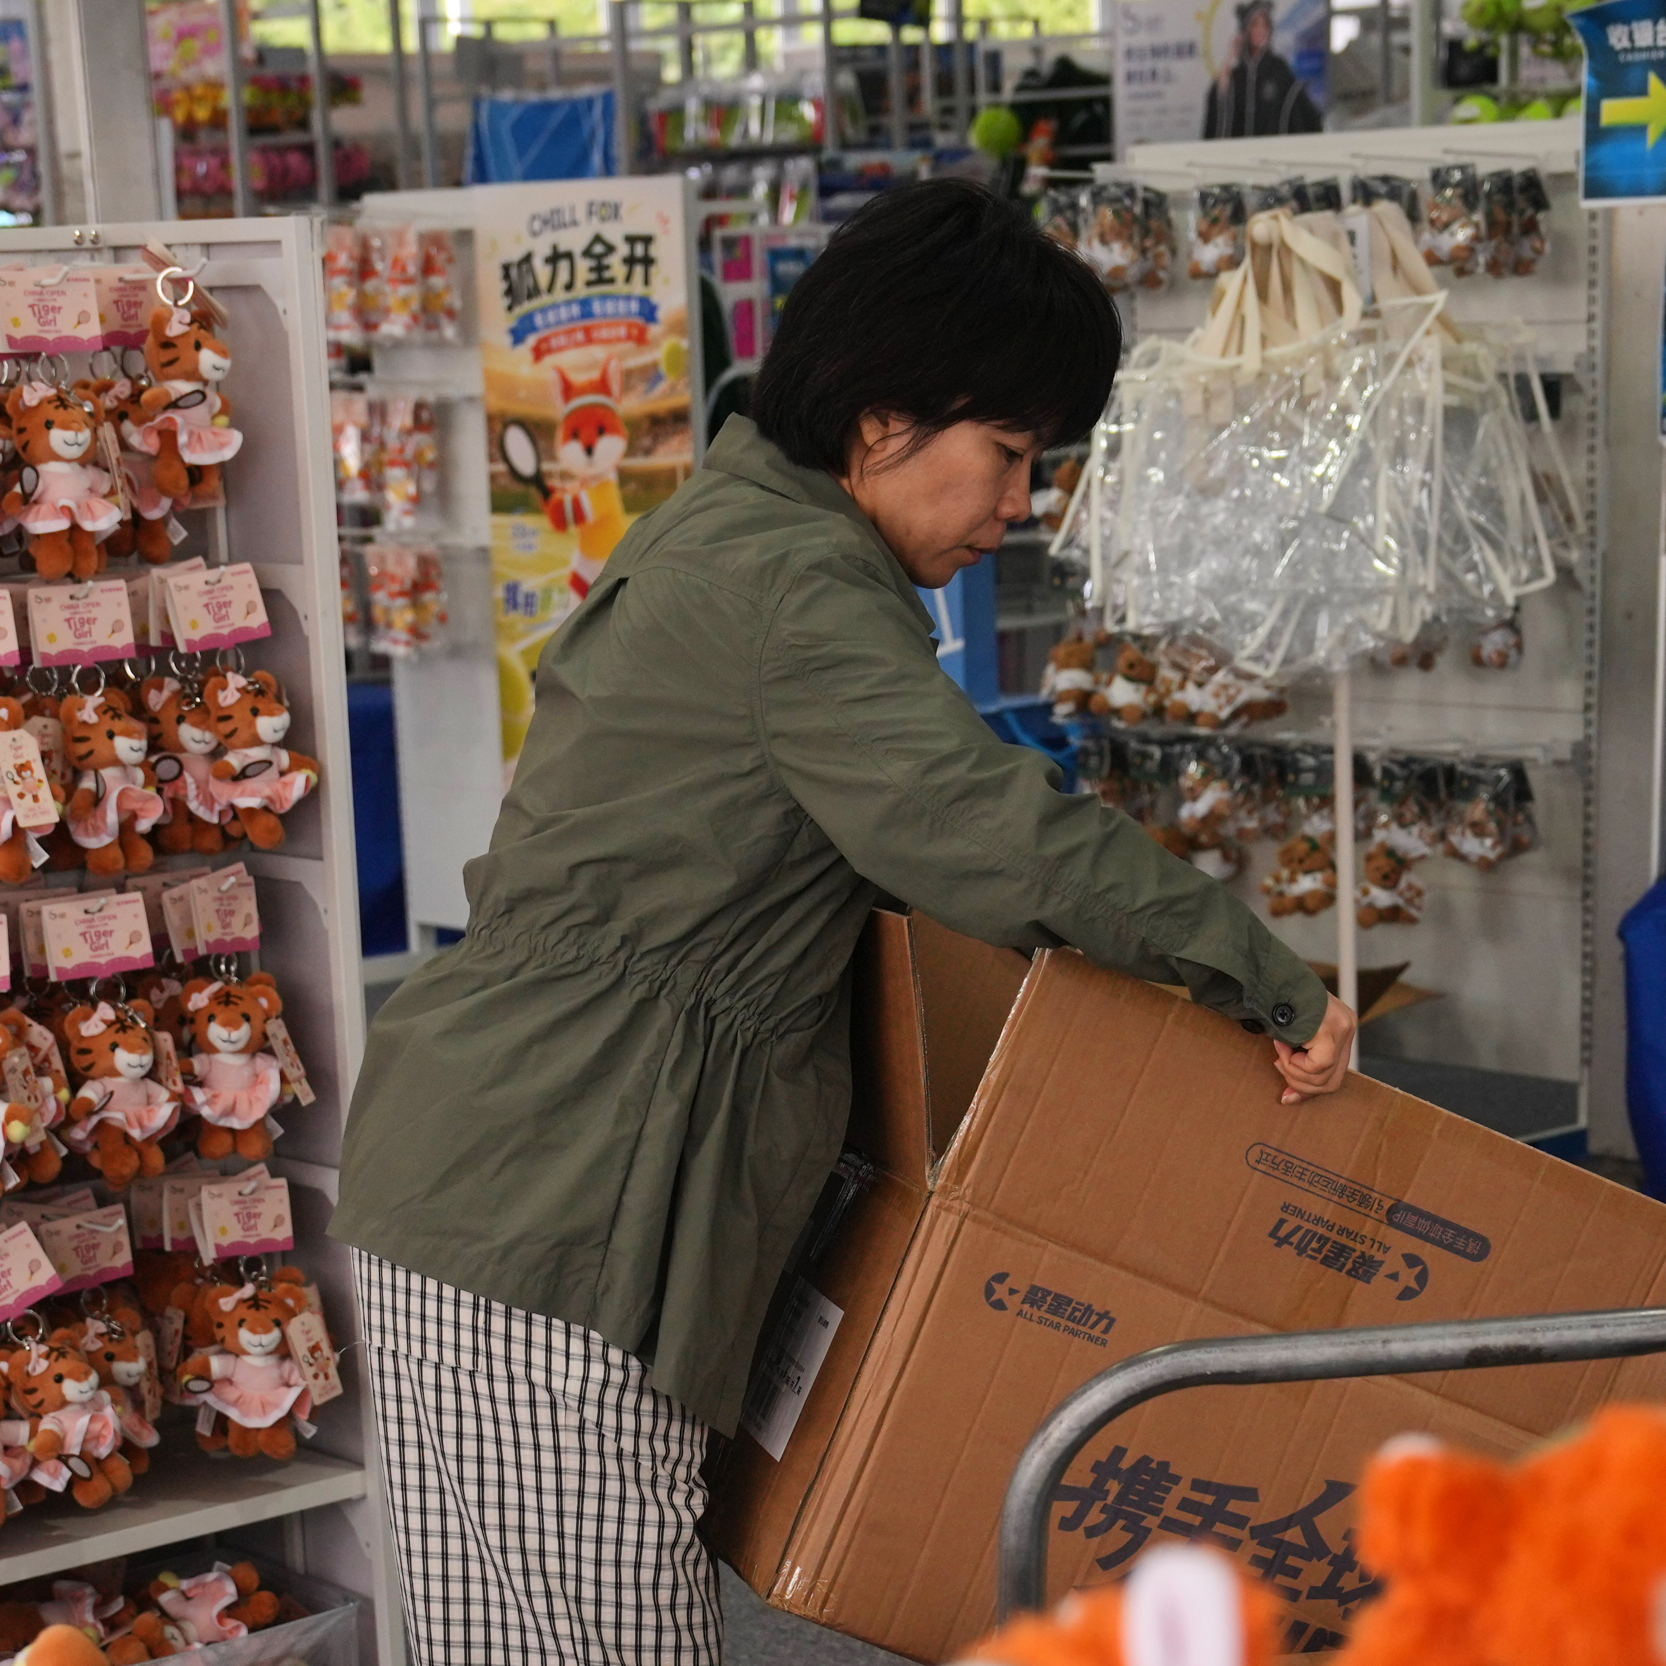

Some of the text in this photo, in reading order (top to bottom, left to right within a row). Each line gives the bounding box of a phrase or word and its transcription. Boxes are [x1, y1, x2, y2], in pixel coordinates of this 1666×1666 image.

[529, 200, 623, 237] CHILL FOX
[501, 233, 656, 313] 狐力全开
[1268, 1217, 1385, 1284] 聚星动力
[1280, 1200, 1392, 1254] ALL STAR PARTNER
[1016, 1309, 1108, 1348] ALL STAR PARTNER
[1020, 1284, 1117, 1335] 聚星动力
